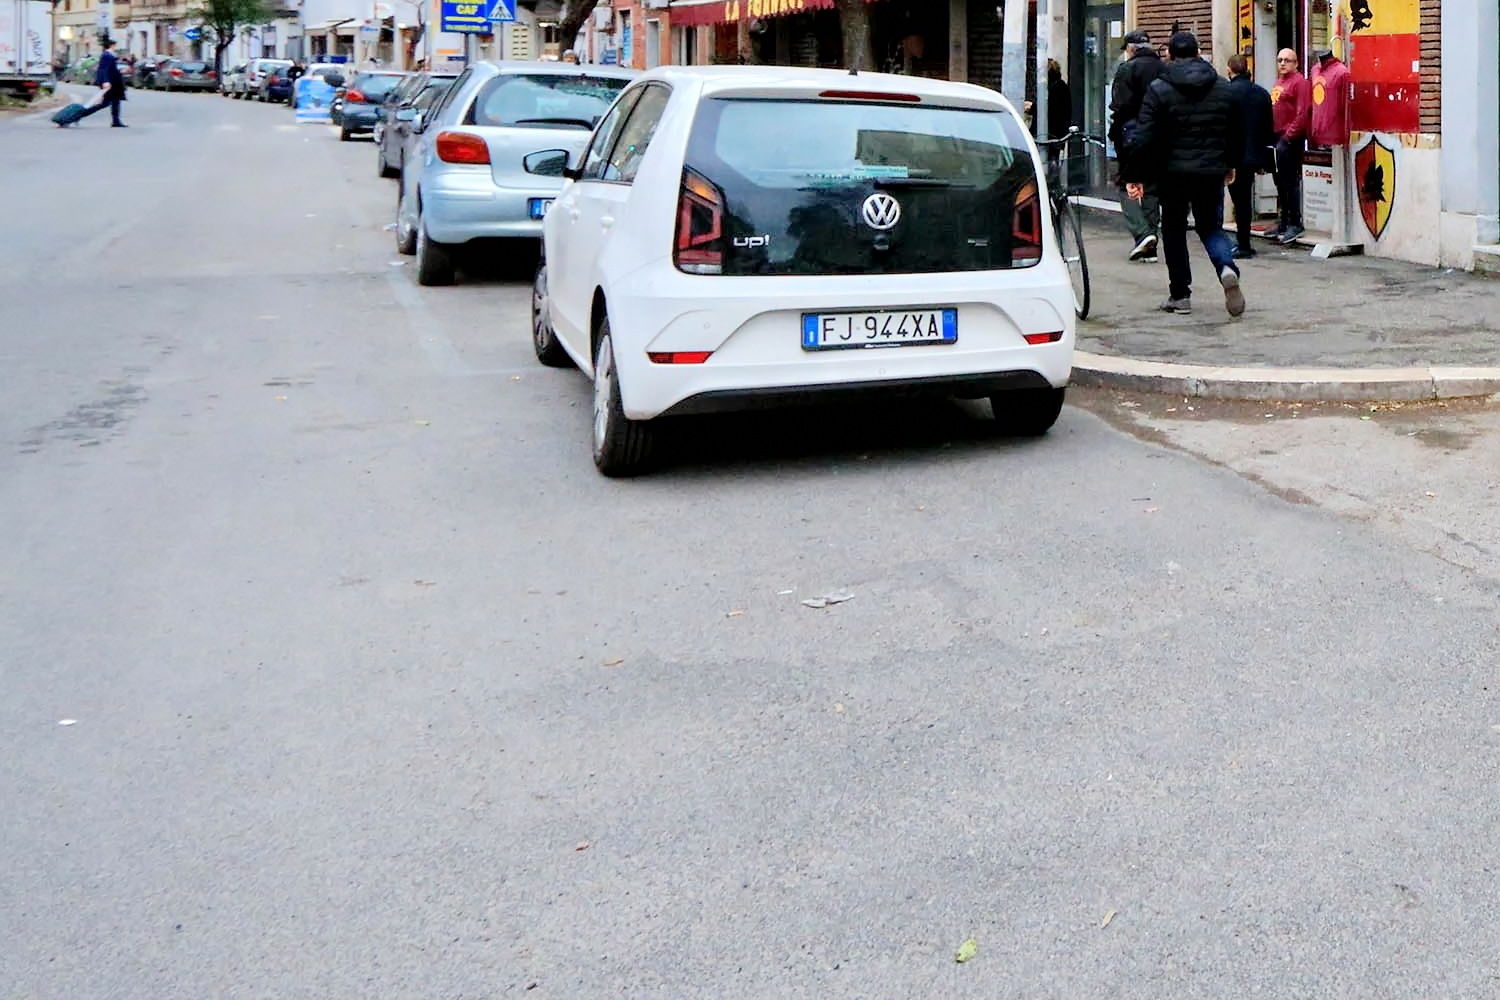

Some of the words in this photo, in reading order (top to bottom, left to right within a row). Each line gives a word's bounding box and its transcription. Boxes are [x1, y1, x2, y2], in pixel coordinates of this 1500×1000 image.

[725, 0, 740, 21] LA
[733, 234, 770, 249] up!
[822, 317, 853, 342] FJ
[864, 314, 939, 339] 944XA
